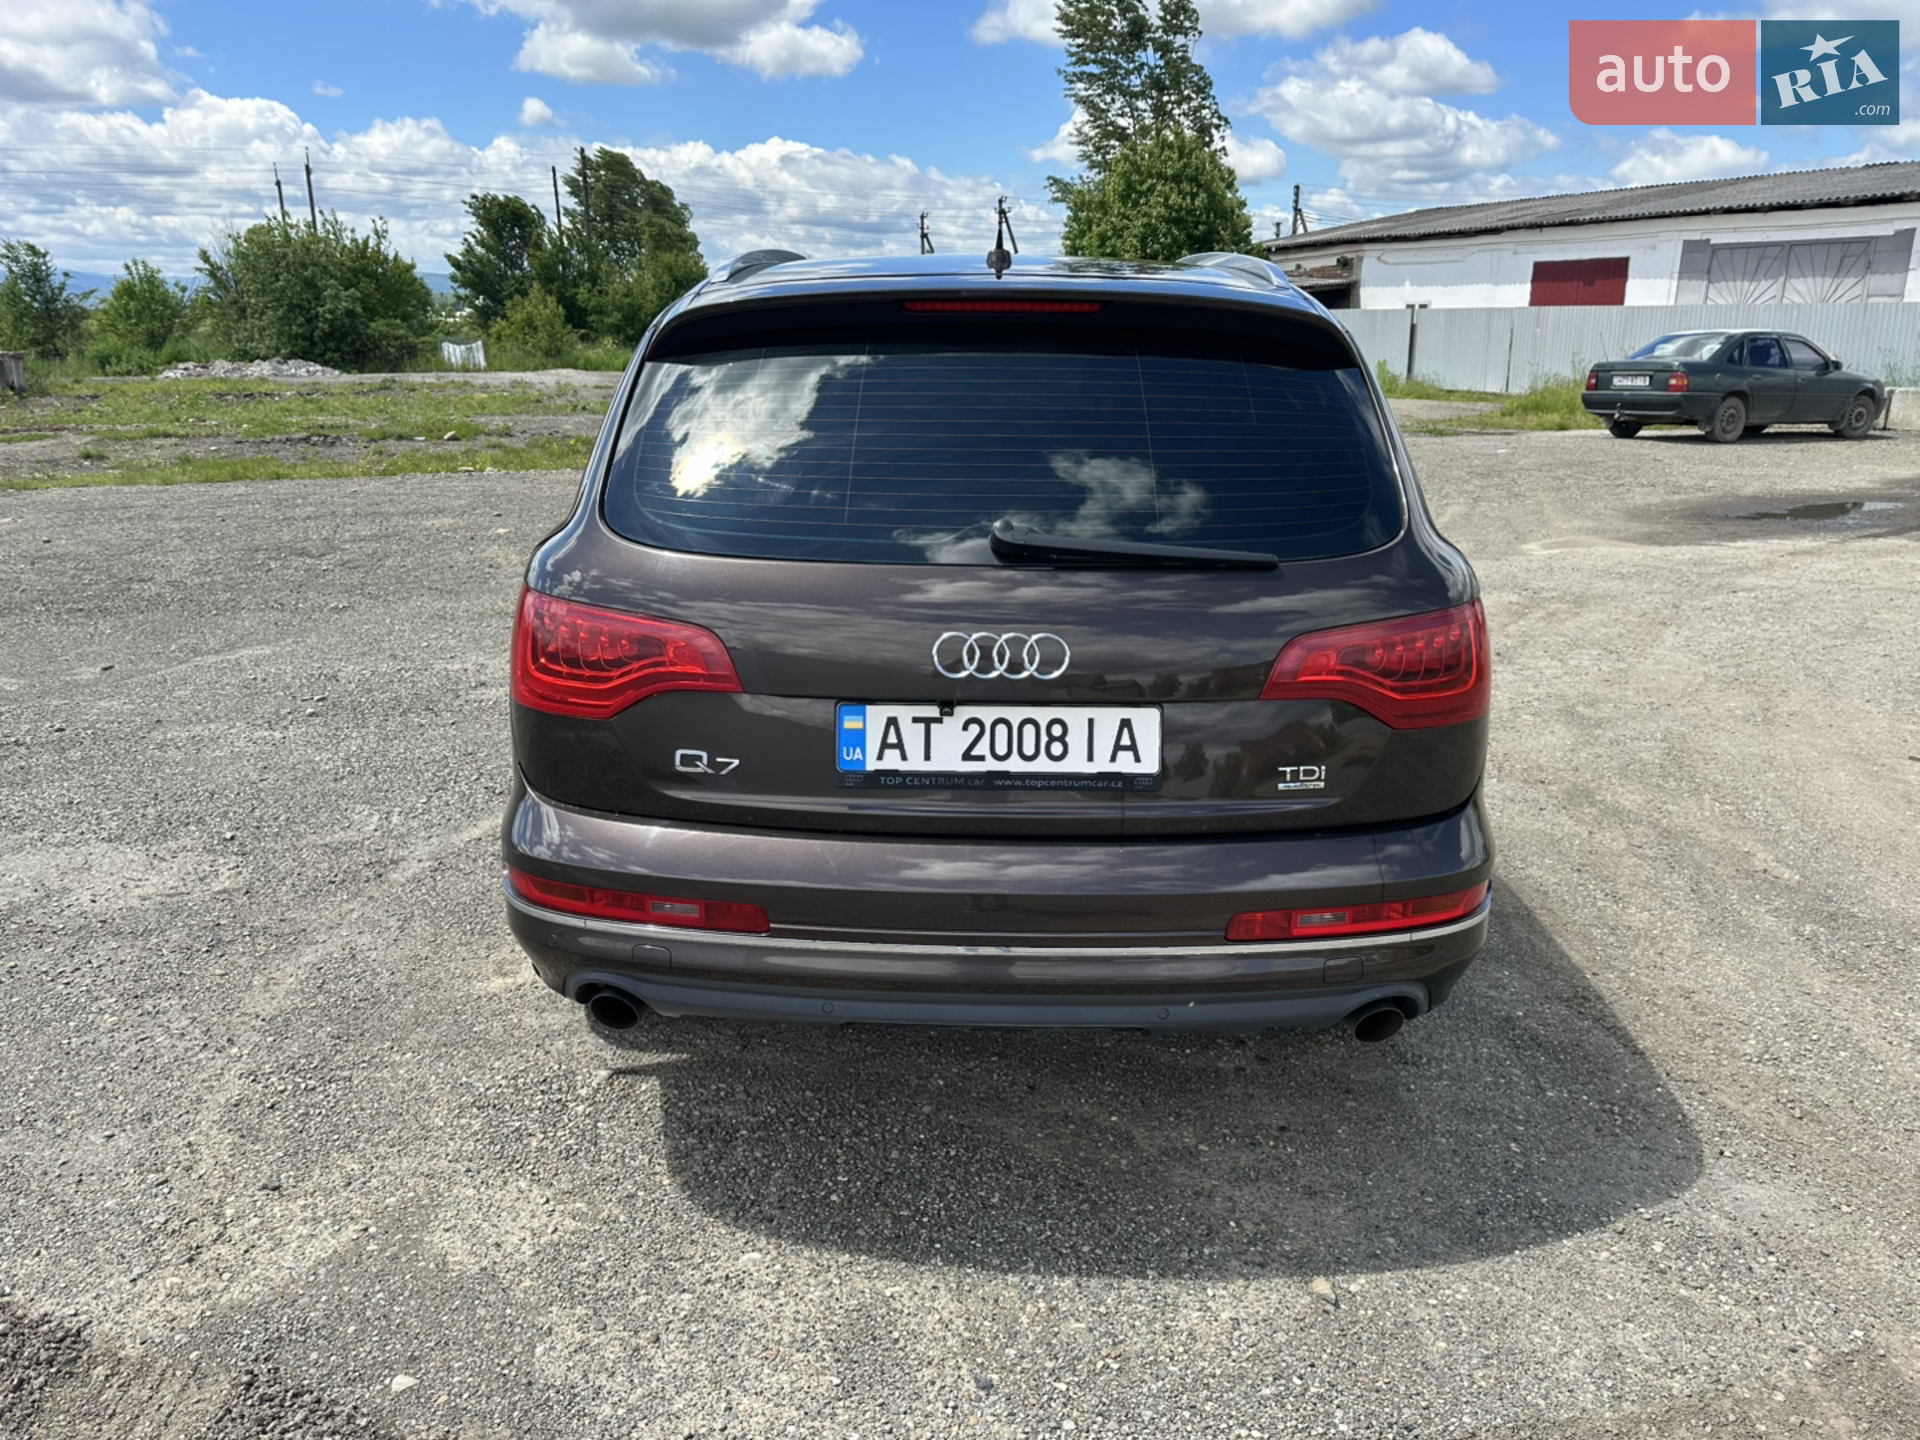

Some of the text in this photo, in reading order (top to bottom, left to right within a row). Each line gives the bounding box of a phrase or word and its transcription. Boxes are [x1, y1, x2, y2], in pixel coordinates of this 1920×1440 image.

[876, 716, 1142, 763] AT 2008 IA
[843, 746, 863, 761] UA
[675, 749, 740, 776] Q7
[879, 776, 903, 785] TOP
[906, 776, 965, 786] CENTRUM
[967, 778, 985, 786] car
[993, 778, 1123, 788] www.topcentrumcar.cz
[1277, 765, 1326, 782] TDI
